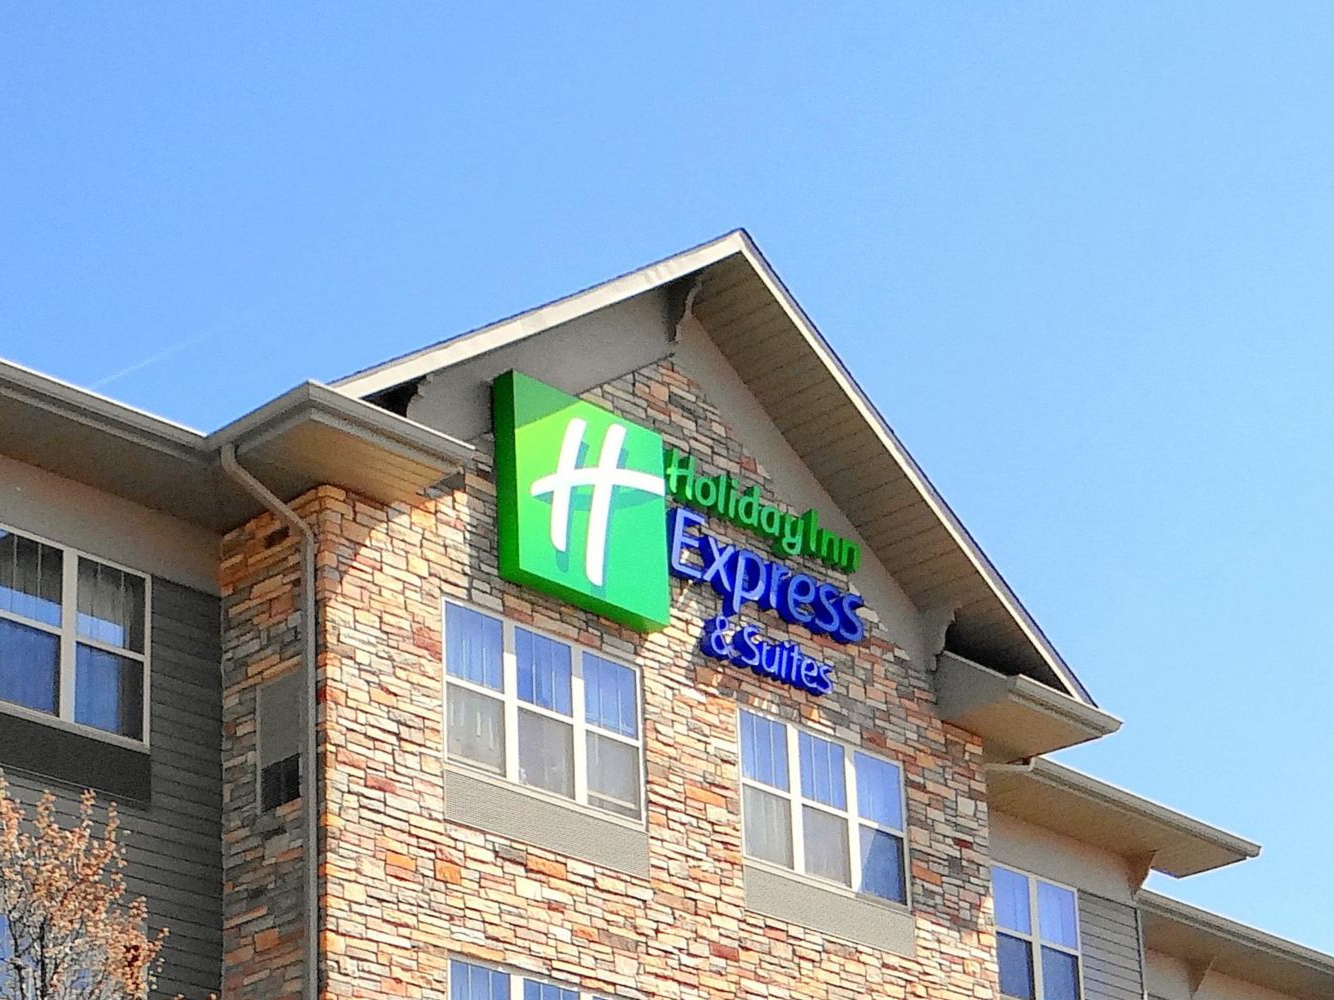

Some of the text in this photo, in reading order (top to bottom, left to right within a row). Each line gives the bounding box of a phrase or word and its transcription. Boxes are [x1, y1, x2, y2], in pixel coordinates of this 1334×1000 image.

[665, 447, 861, 572] Holiday Inn
[670, 507, 865, 643] Express
[708, 615, 834, 695] & Suites
